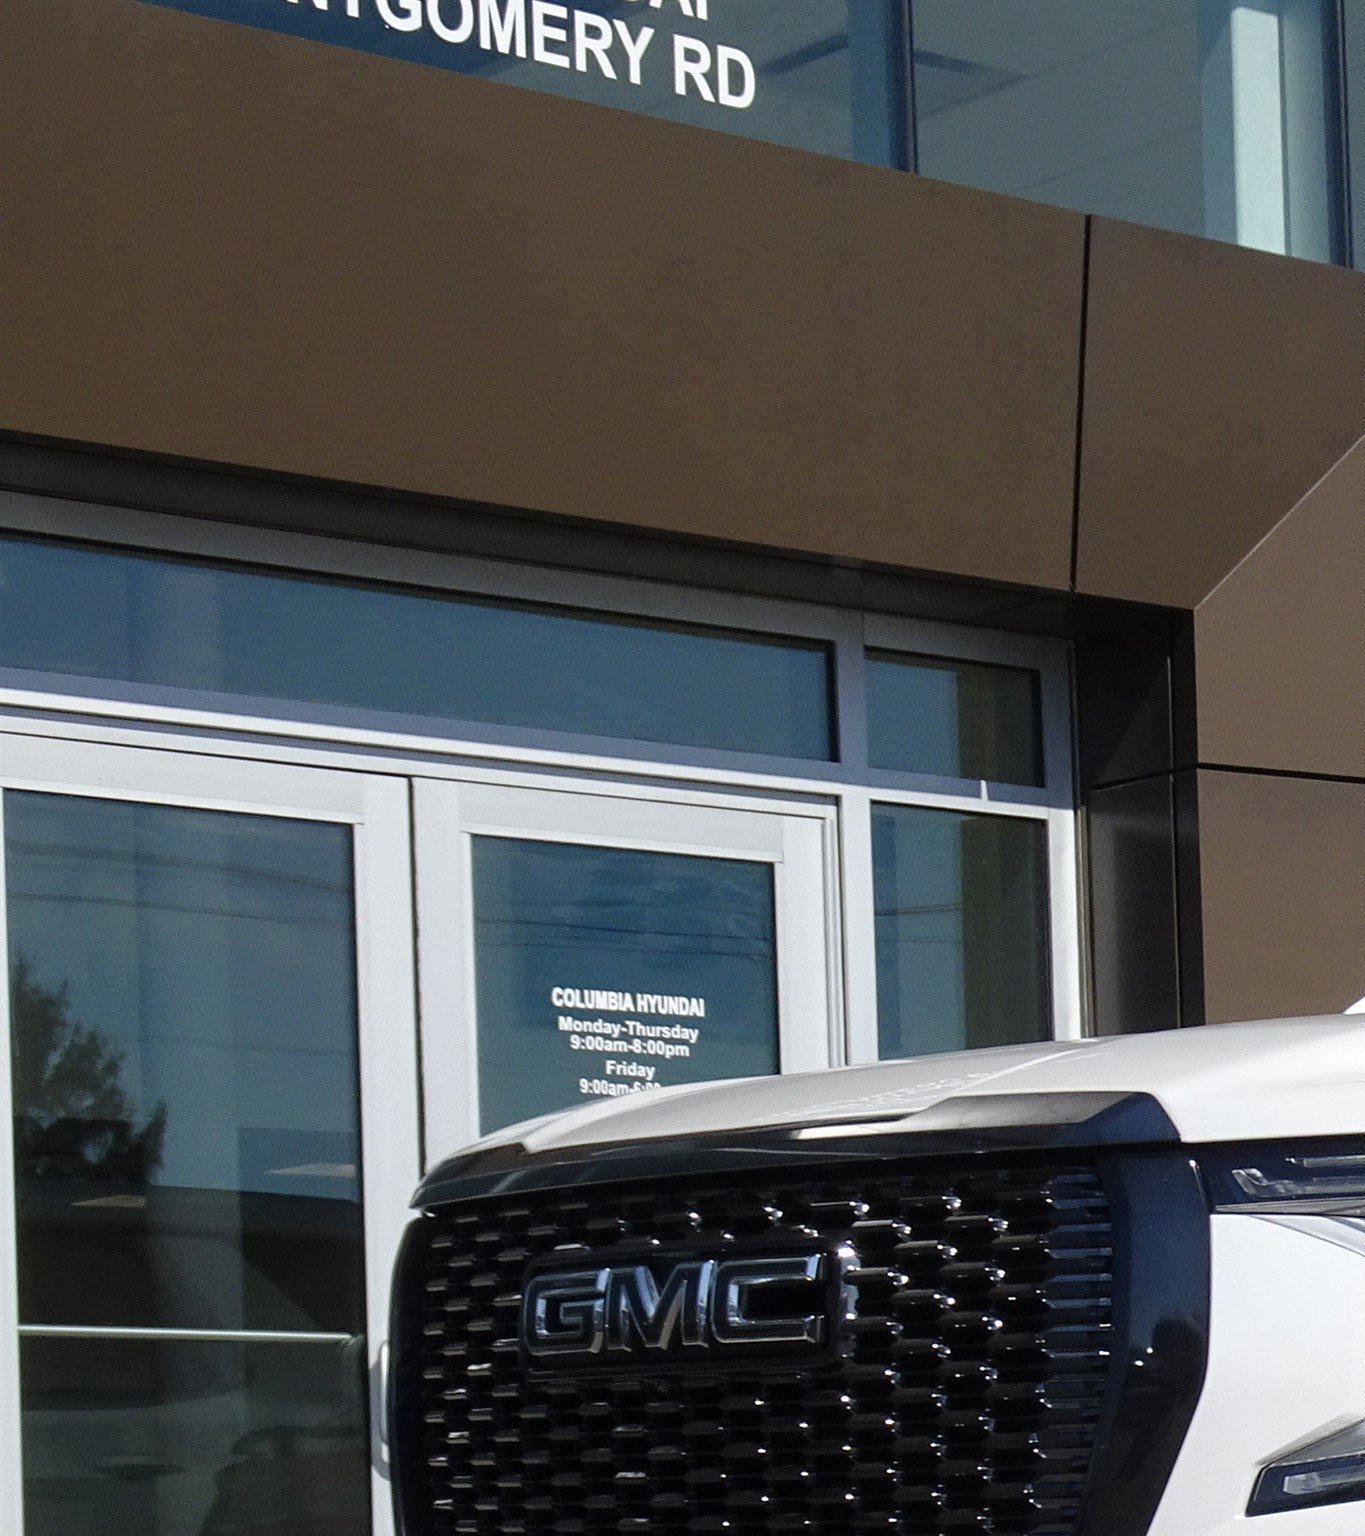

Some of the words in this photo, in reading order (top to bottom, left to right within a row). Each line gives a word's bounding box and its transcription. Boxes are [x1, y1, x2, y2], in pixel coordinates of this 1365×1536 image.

[286, 0, 655, 85] GOMERY
[673, 34, 756, 109] RD
[551, 986, 635, 1012] COLUMBIA
[636, 992, 706, 1018] HYUNDAI
[557, 1015, 700, 1044] Monday-Thursday
[570, 1034, 691, 1059] 9:00am-8:00pm
[605, 1060, 656, 1081] Friday
[522, 1253, 826, 1356] GMC
